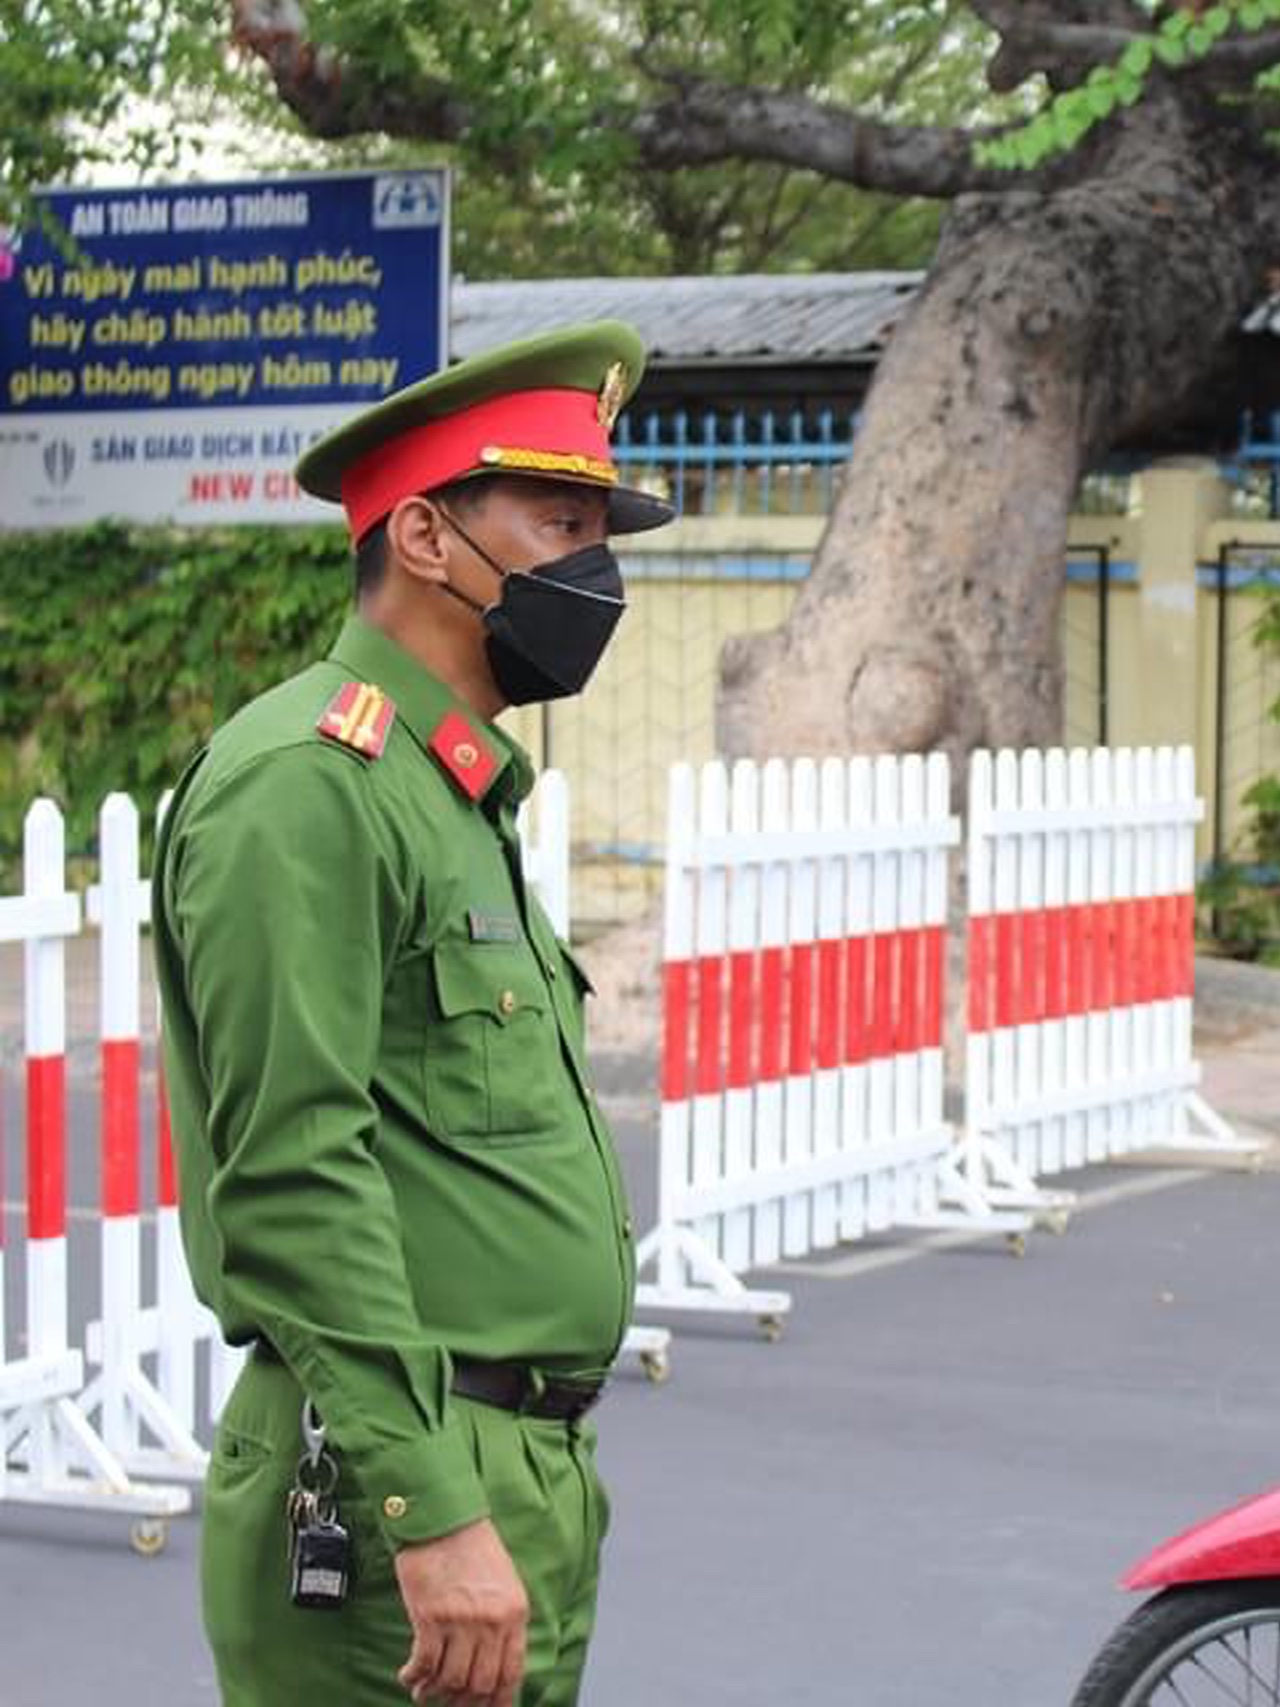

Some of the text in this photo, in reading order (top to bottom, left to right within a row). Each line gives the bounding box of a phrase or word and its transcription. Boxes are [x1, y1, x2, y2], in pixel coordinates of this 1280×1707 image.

[71, 188, 309, 236] AN TOÀN GIAO THÔNG
[63, 260, 135, 301] ngày
[144, 257, 200, 293] mai
[209, 255, 287, 295] hạnh
[296, 248, 382, 293] phúc,
[31, 312, 85, 354] hãy
[173, 307, 250, 341] hành
[314, 300, 376, 343] luật
[10, 352, 398, 402] giao thông ngay hôm nay
[144, 433, 195, 461] GIAO
[190, 473, 253, 502] NEW
